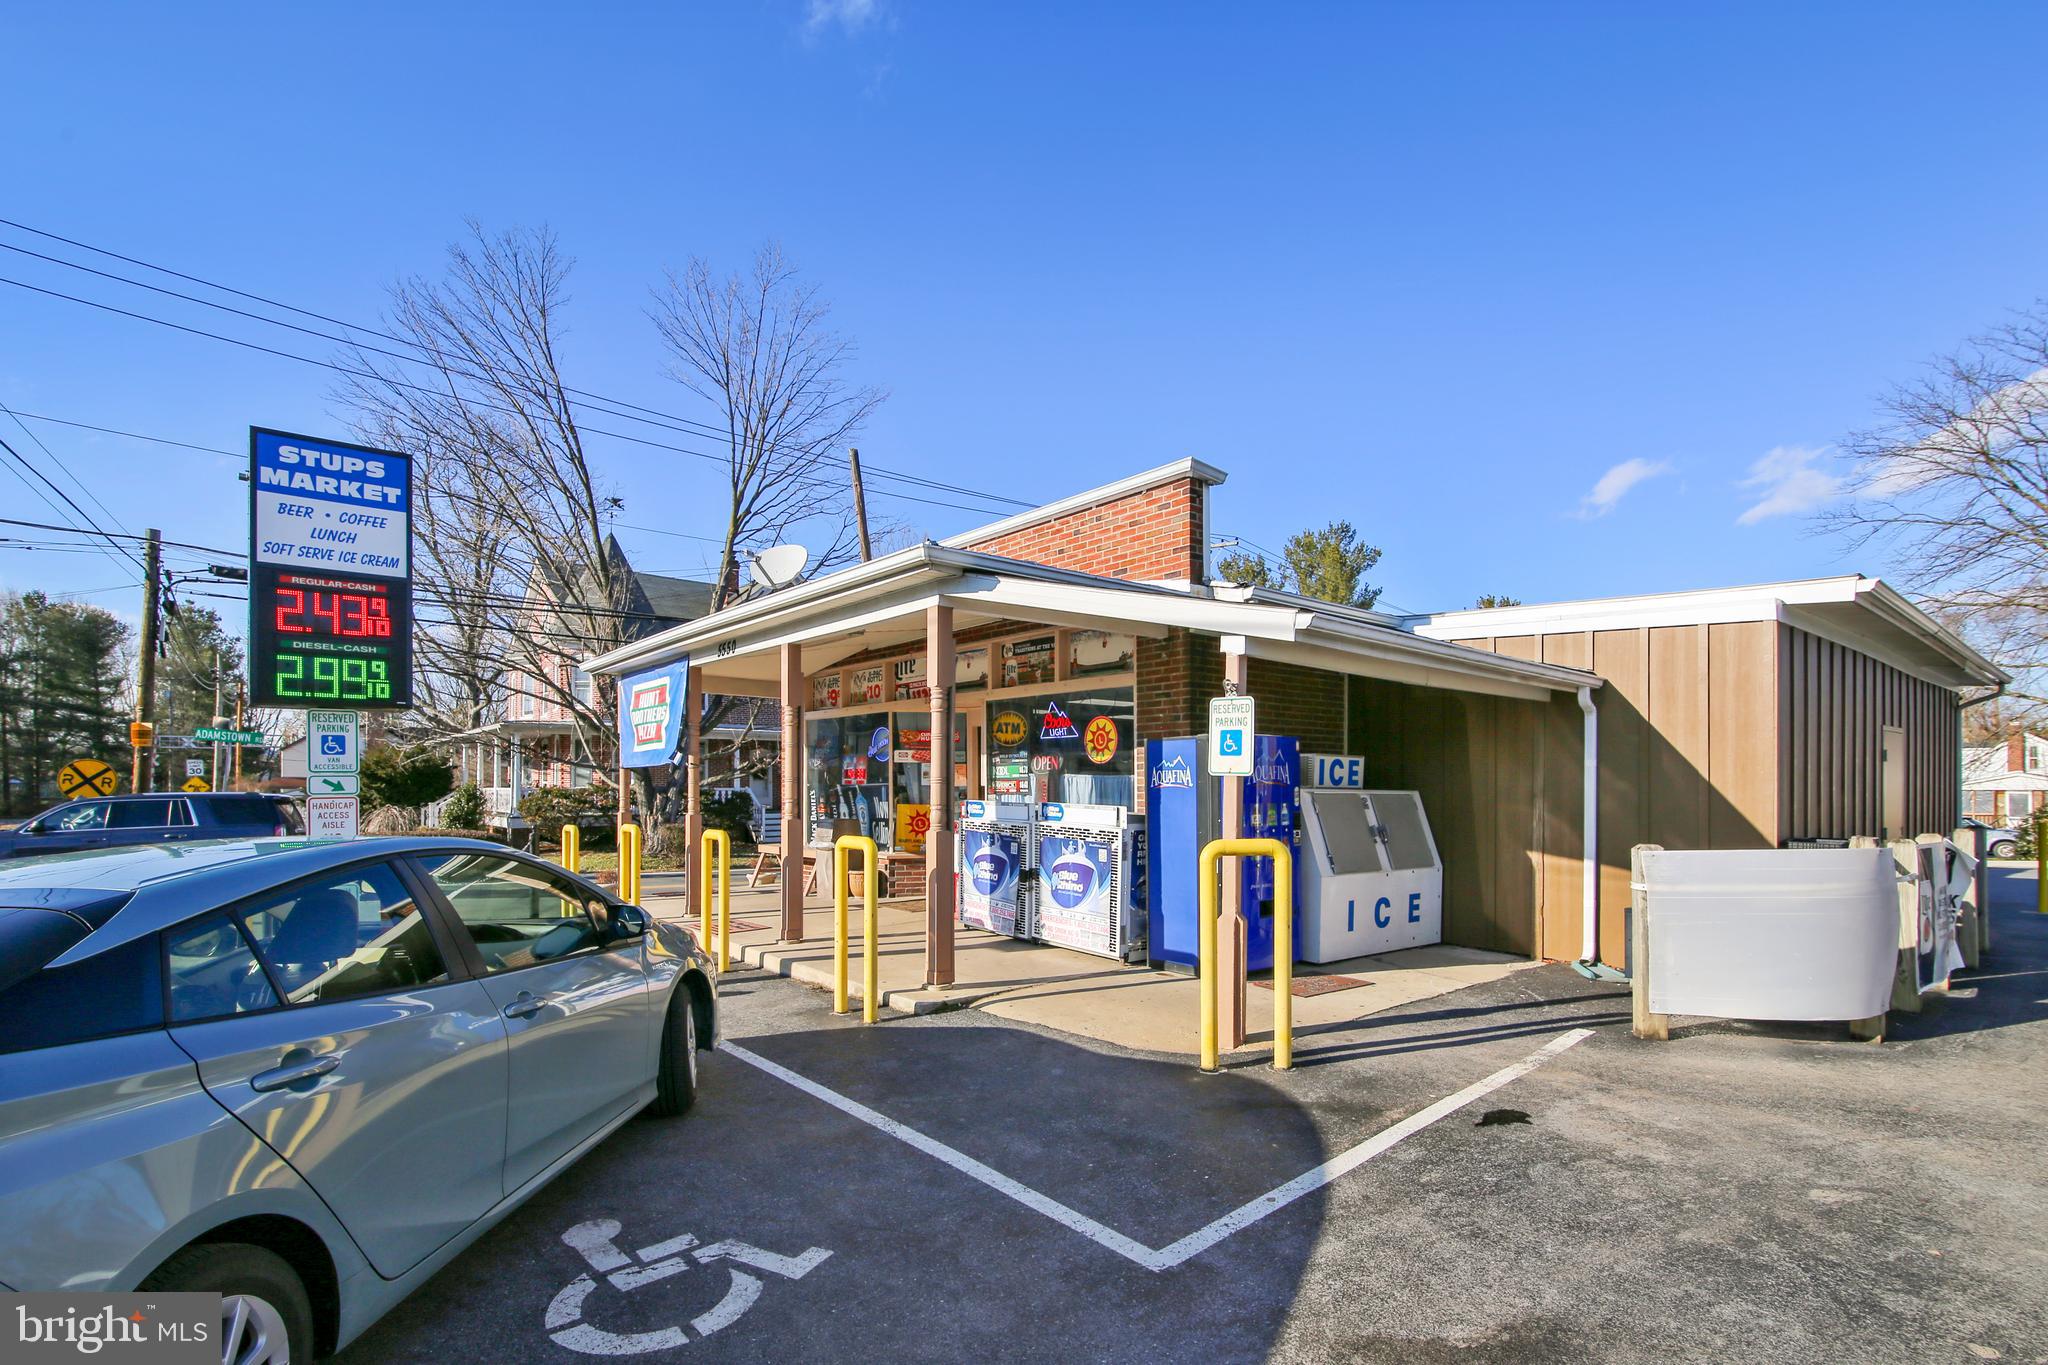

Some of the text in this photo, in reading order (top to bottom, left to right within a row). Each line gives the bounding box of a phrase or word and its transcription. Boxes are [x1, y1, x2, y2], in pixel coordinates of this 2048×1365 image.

[278, 445, 385, 478] STUPS
[260, 466, 401, 504] MARKET
[277, 502, 388, 529] BEER COFFEE
[310, 527, 357, 544] LUNCH
[263, 541, 400, 569] SOFT SERVE ICE CREAM
[291, 576, 376, 592] REGULAR-CASH
[276, 588, 369, 637] 2.43
[292, 641, 377, 654] DIESEL-CASH
[276, 654, 367, 700] 2.99
[1213, 704, 1250, 714] RESERVED
[312, 712, 354, 723] RESERVED
[1043, 713, 1072, 729] Coors
[1215, 716, 1248, 727] PARKING
[195, 729, 251, 742] ADAMSTOWN
[316, 724, 350, 733] PARKING
[996, 724, 1021, 735] ATM
[1050, 727, 1067, 737] LIGHT
[1033, 755, 1059, 771] OPEN
[62, 773, 113, 788] R R
[1150, 764, 1193, 787] AQUAFINA
[1318, 758, 1360, 787] ICE
[312, 802, 354, 810] HANDICAP
[321, 821, 345, 829] AISLE
[873, 821, 889, 845] Sellin
[1058, 870, 1079, 882] Blue
[1347, 892, 1421, 932] ICE
